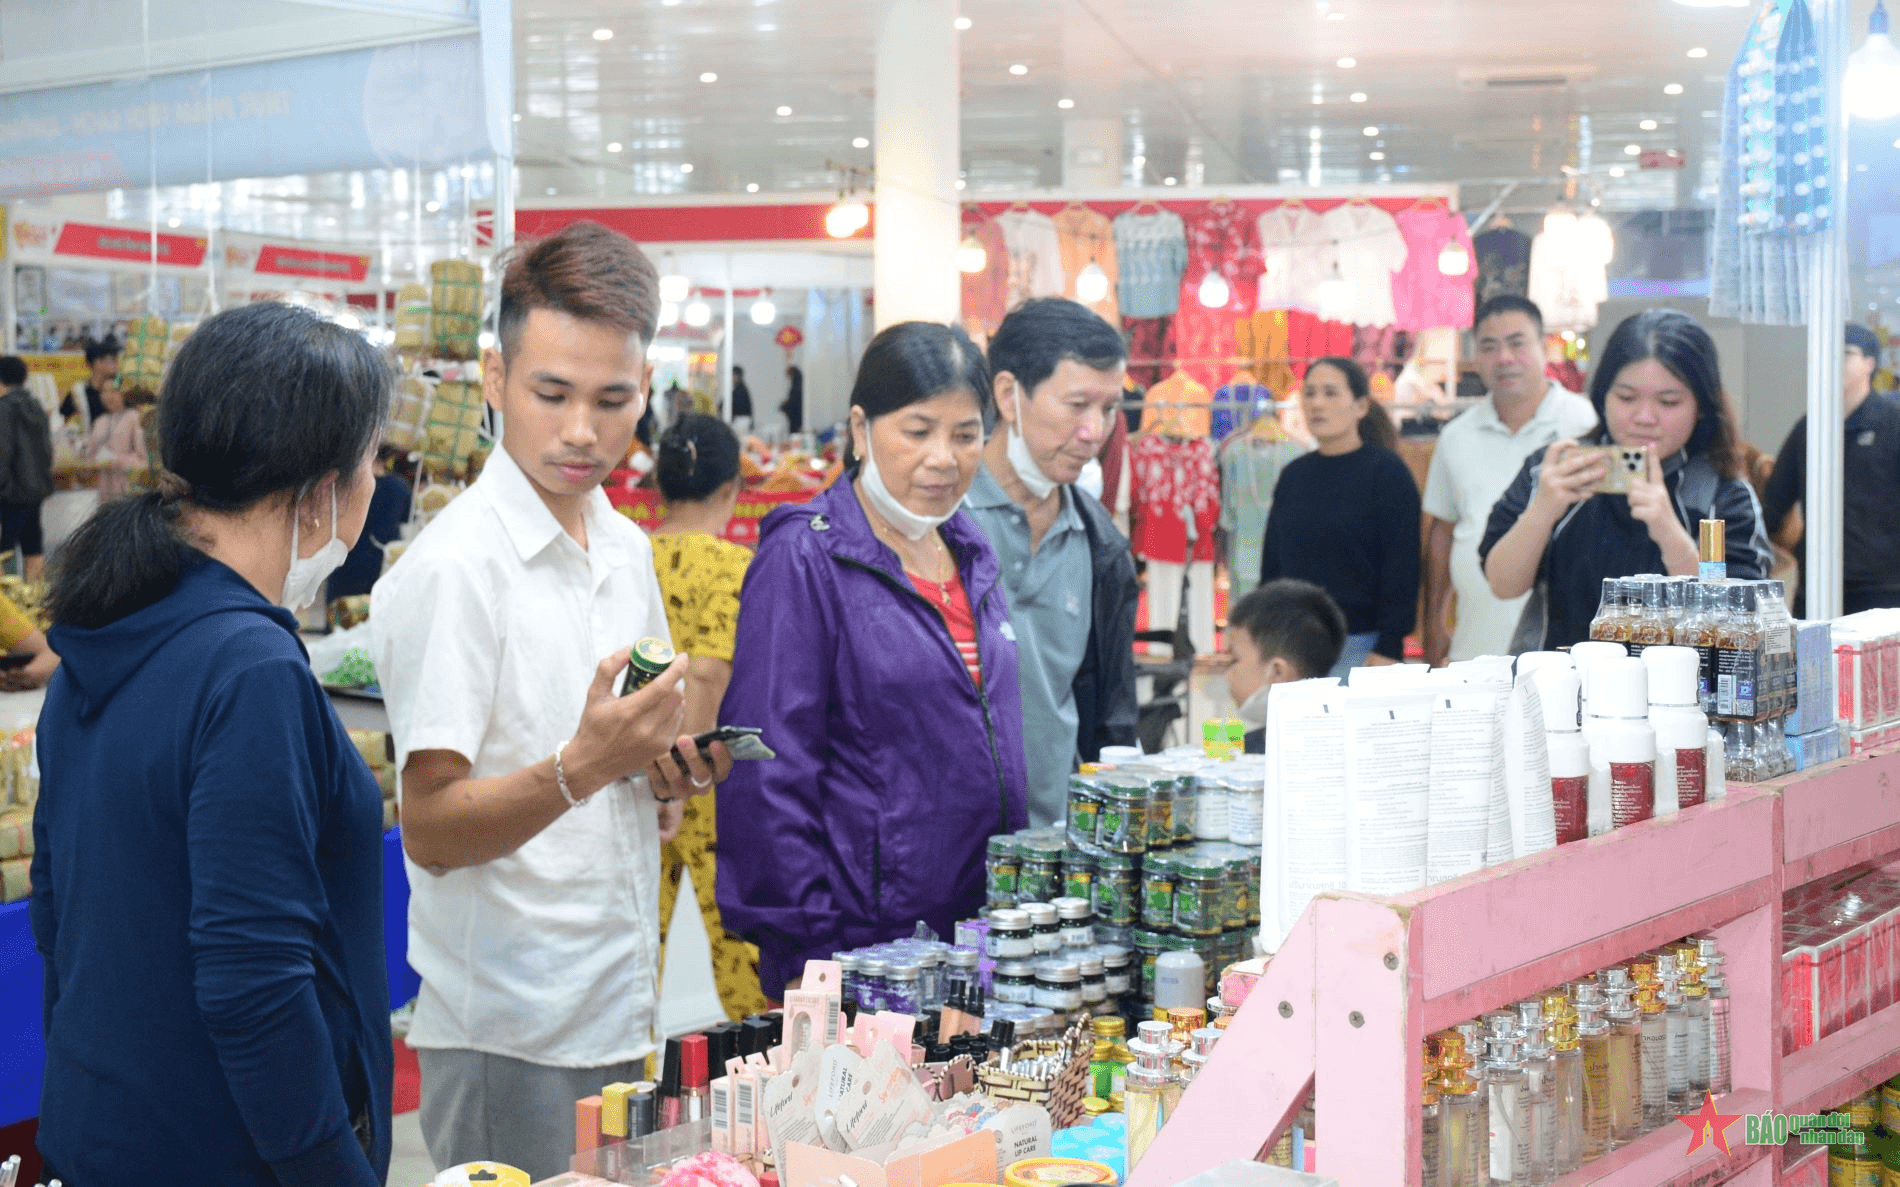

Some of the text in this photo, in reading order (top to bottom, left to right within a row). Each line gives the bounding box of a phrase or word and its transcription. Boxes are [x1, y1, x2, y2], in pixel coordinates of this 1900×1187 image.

[839, 1067, 848, 1098] ATURAL
[1013, 1135, 1038, 1149] NATURAL
[1014, 1144, 1036, 1157] LIP CARE
